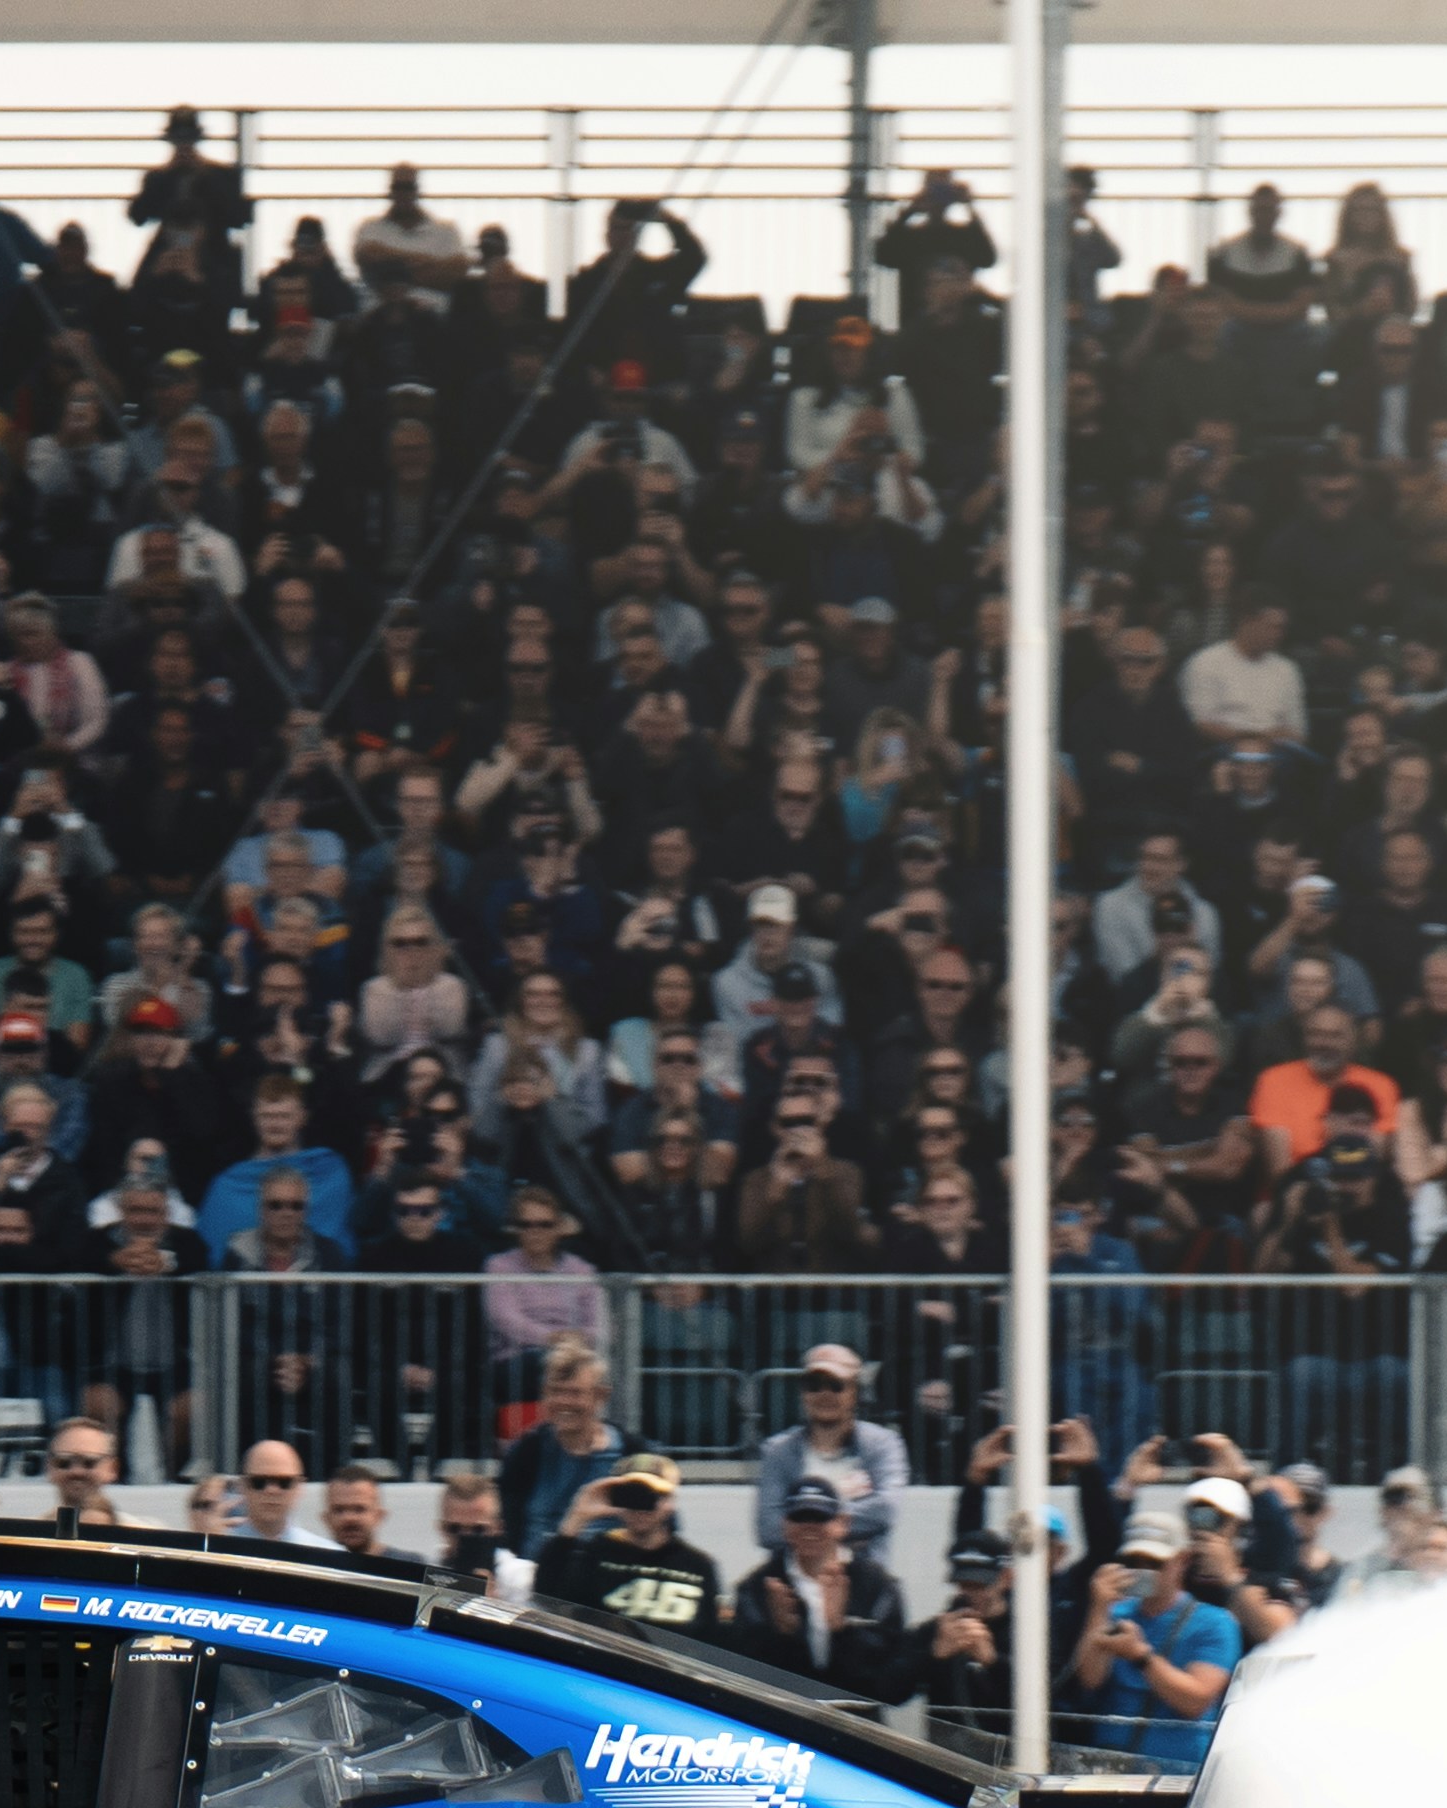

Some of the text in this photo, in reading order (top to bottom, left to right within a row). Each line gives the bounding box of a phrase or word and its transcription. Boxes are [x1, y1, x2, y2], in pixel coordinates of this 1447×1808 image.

[83, 1597, 328, 1646] M. ROCKENFELLER
[602, 1577, 705, 1623] 46
[128, 1652, 194, 1662] CHEVROLET
[585, 1724, 816, 1783] Hendrick
[625, 1767, 808, 1785] MOTORSPORTS
